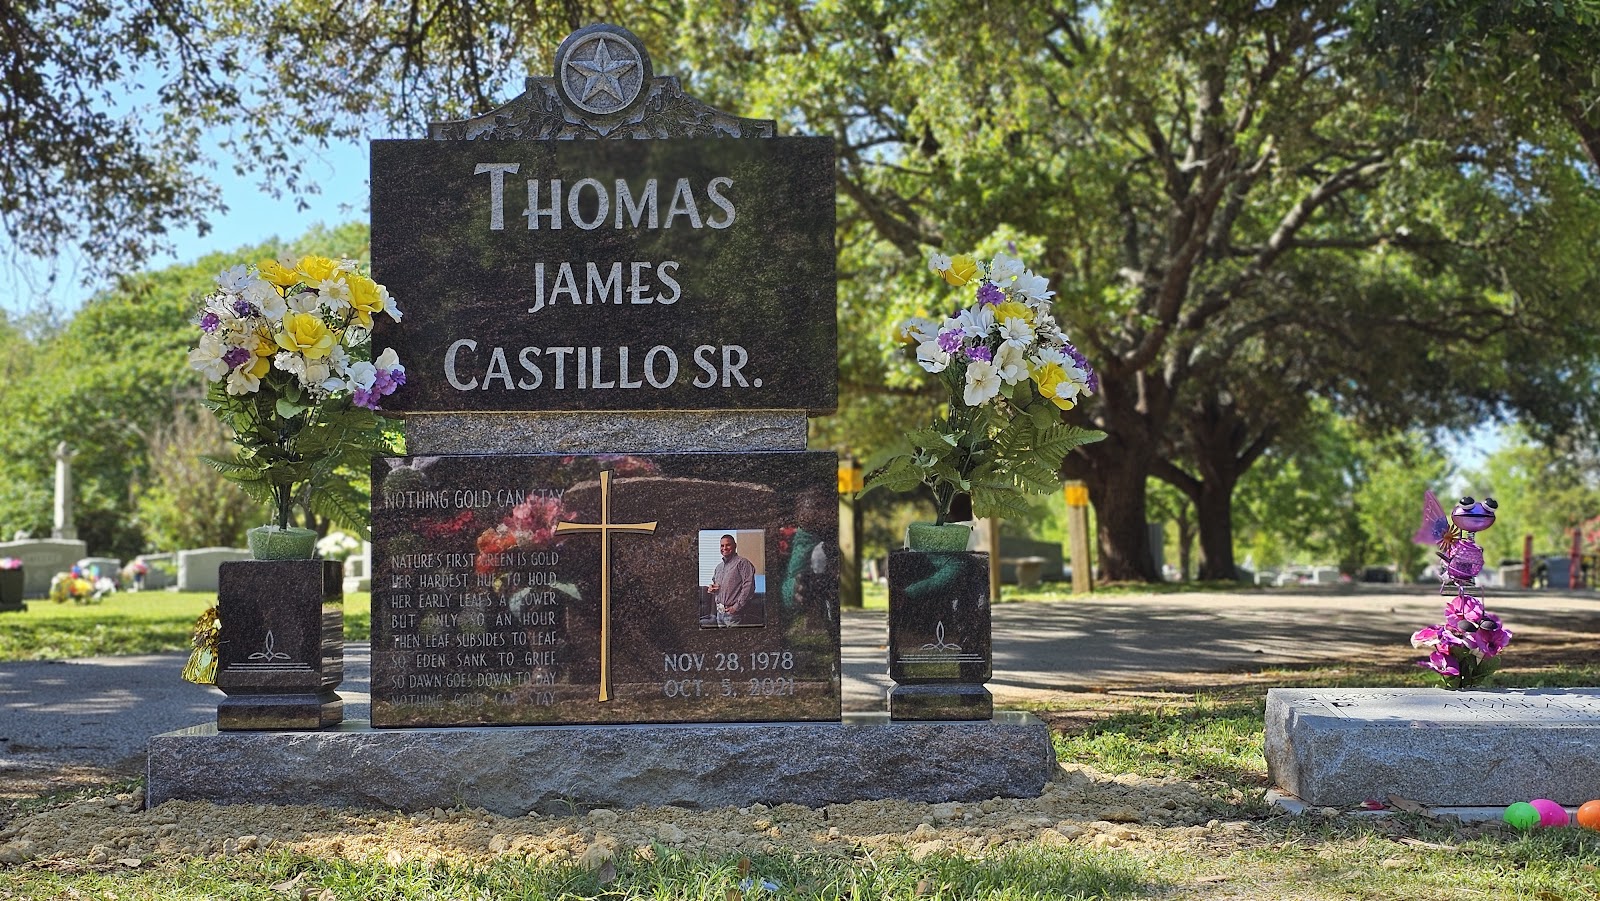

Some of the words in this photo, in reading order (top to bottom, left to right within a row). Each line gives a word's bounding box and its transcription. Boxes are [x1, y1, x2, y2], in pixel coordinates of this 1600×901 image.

[473, 162, 736, 230] THOMAS
[528, 260, 681, 313] JAMES
[444, 339, 679, 391] CASTILLO
[693, 344, 763, 389] SR.
[385, 490, 449, 509] NOTHING
[454, 489, 492, 508] GOLD
[497, 489, 525, 508] CAN
[531, 488, 565, 507] STAY
[391, 553, 442, 568] NATURE'S
[446, 553, 476, 568] FIRST
[481, 552, 514, 567] GREEN
[517, 551, 527, 566] IS
[531, 551, 559, 566] GOLD
[392, 574, 412, 588] HER
[420, 573, 469, 588] HARDEST
[505, 571, 521, 586] TO
[391, 594, 412, 608] HER
[419, 593, 452, 608] EARLY
[499, 593, 507, 606] A
[391, 614, 416, 628] BUT
[427, 613, 458, 628] ONLY
[470, 611, 485, 627] SO
[495, 613, 512, 626] AN
[392, 633, 420, 648] THEN
[425, 633, 450, 648] LEAF
[456, 631, 505, 648] SUBSIDES
[511, 631, 527, 646] TO
[531, 630, 557, 646] LEAF
[391, 653, 407, 669] SO
[416, 653, 446, 668] EDEN
[456, 652, 488, 668] SANK
[498, 652, 515, 667] TO
[525, 651, 559, 666] GRIEF.
[664, 653, 710, 671] NOV.
[715, 652, 745, 673] 28,
[750, 651, 794, 670] 1978
[391, 675, 405, 689] SO
[409, 674, 442, 688] DAWN
[446, 672, 472, 687] GOES
[477, 672, 511, 687] DOWN
[516, 671, 530, 686] TO
[536, 671, 557, 685] DAY
[663, 679, 709, 698] OCT.
[721, 678, 737, 698] 5,
[749, 677, 794, 696] 2021
[391, 694, 443, 708] NOTHING
[453, 693, 484, 707] GOLD
[529, 692, 556, 706] STAY
